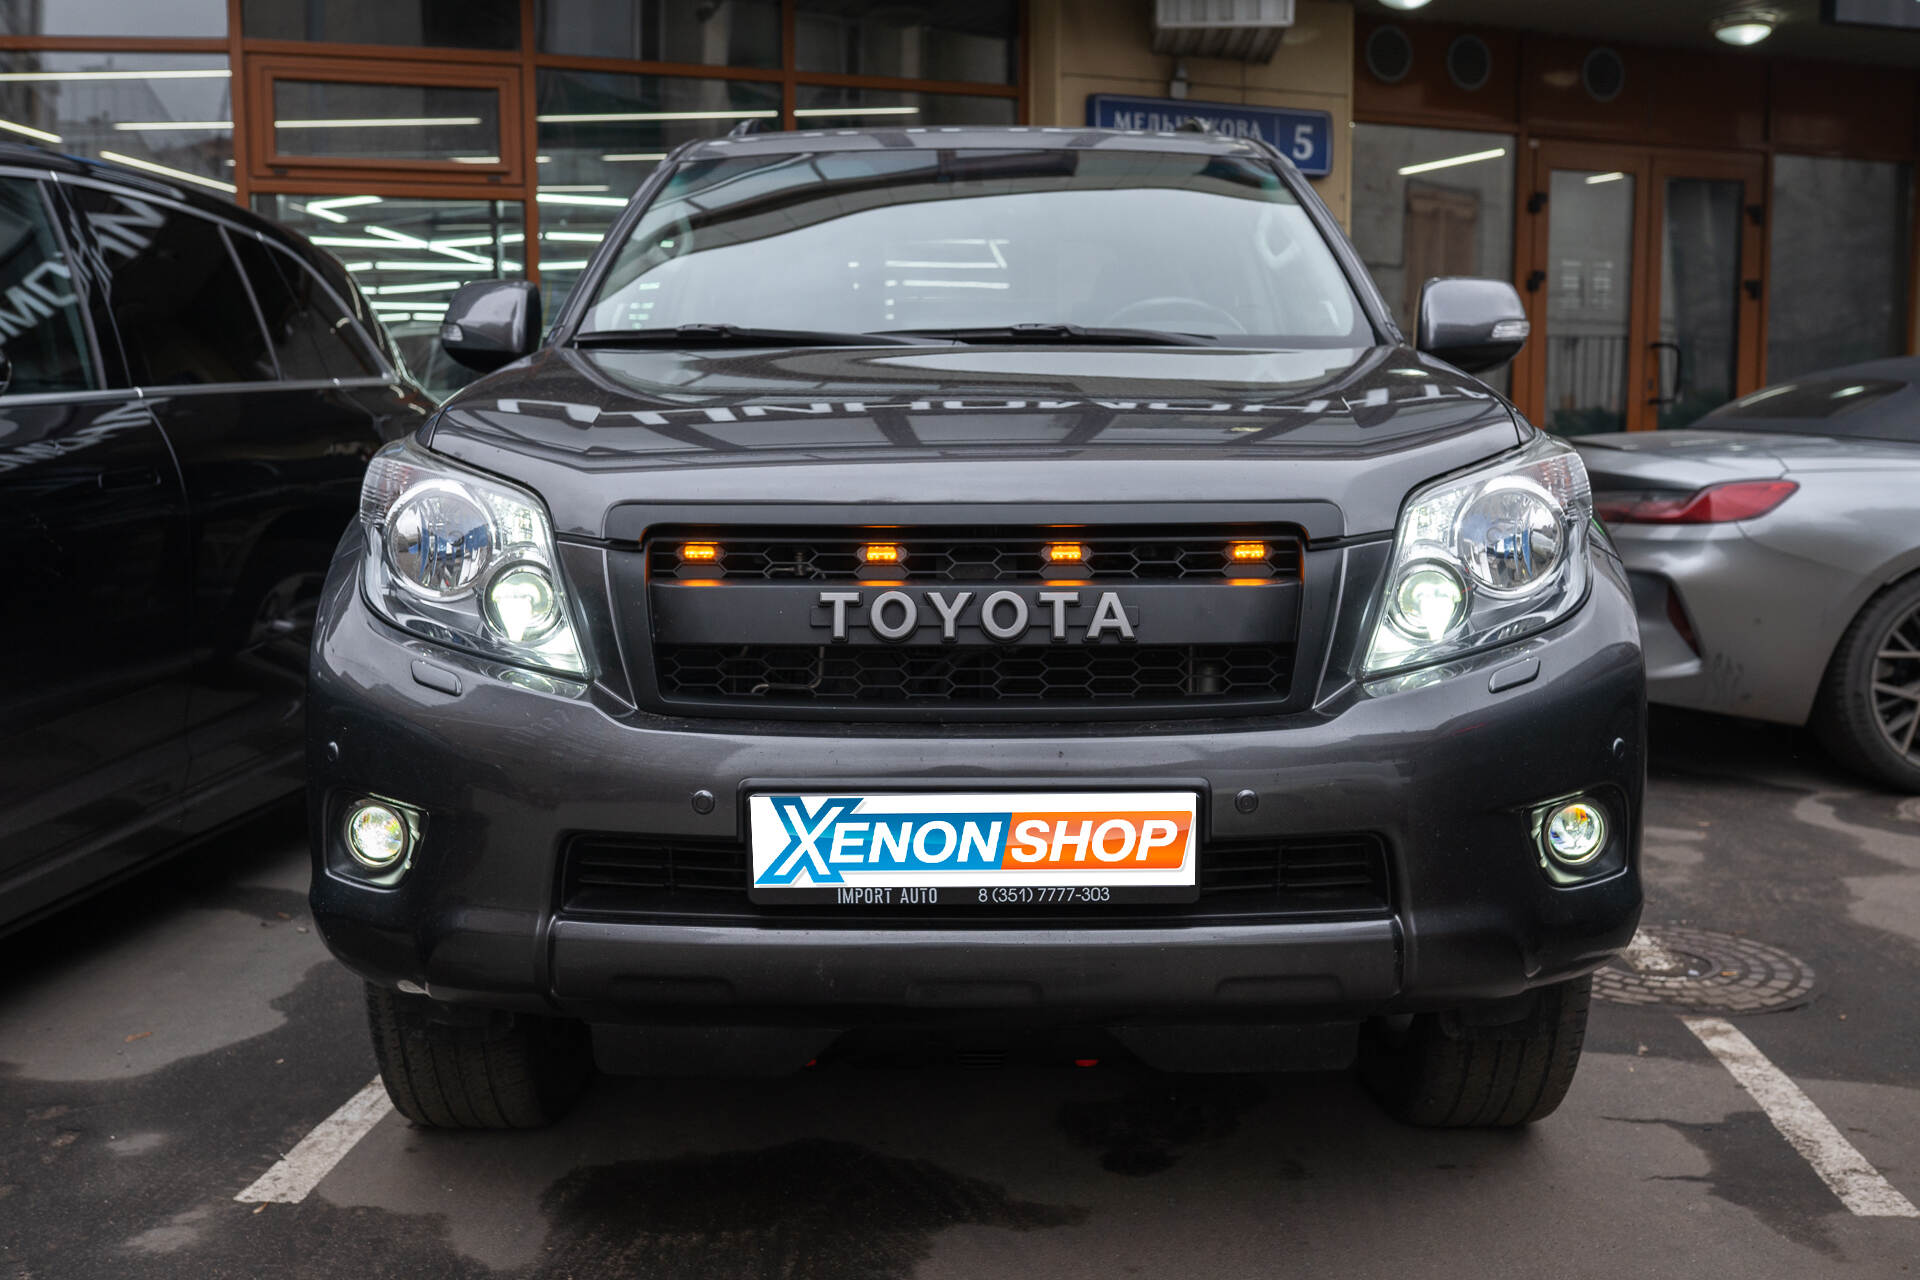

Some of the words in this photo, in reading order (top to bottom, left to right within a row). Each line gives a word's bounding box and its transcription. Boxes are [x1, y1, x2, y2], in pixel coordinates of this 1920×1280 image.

[1292, 125, 1315, 161] 5
[818, 590, 1136, 640] TOYOTA
[836, 887, 893, 904] IMPORT
[899, 887, 938, 904] AUTO
[977, 888, 989, 903] 8
[991, 886, 1034, 904] (351)
[1036, 886, 1111, 903] 7777-303
